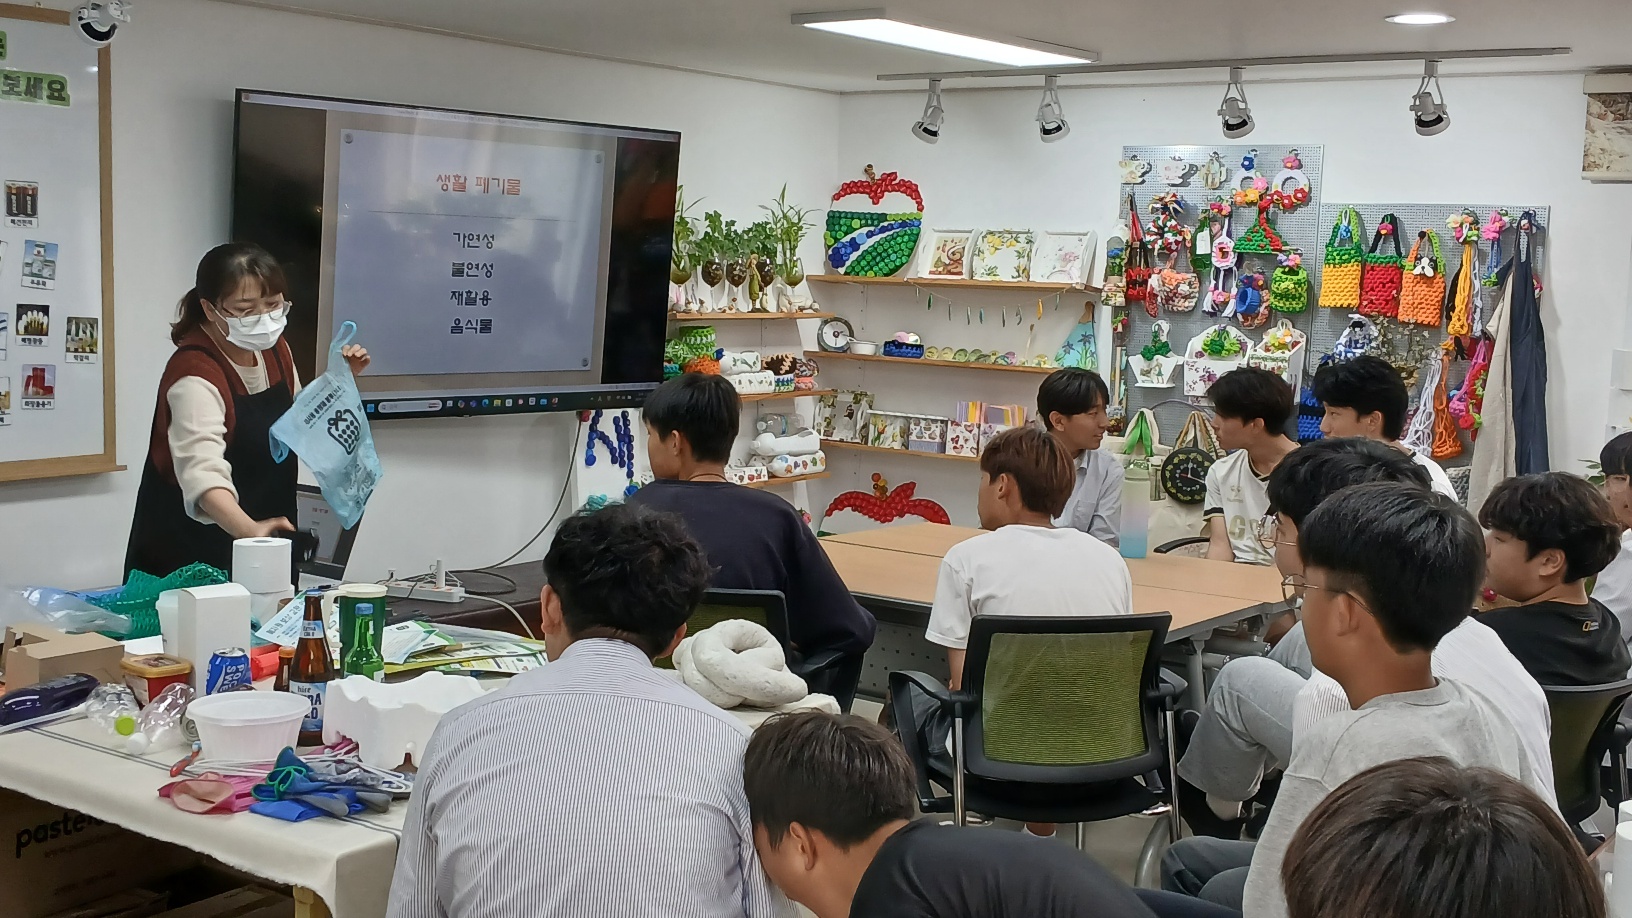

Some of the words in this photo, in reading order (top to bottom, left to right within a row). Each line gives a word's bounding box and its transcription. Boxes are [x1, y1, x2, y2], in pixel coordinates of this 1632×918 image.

[1, 73, 66, 102] 보세요
[436, 173, 468, 193] 생활
[453, 232, 495, 250] 가연성
[451, 261, 494, 279] 불연성
[450, 289, 493, 307] 재활용
[450, 317, 493, 335] 음식물
